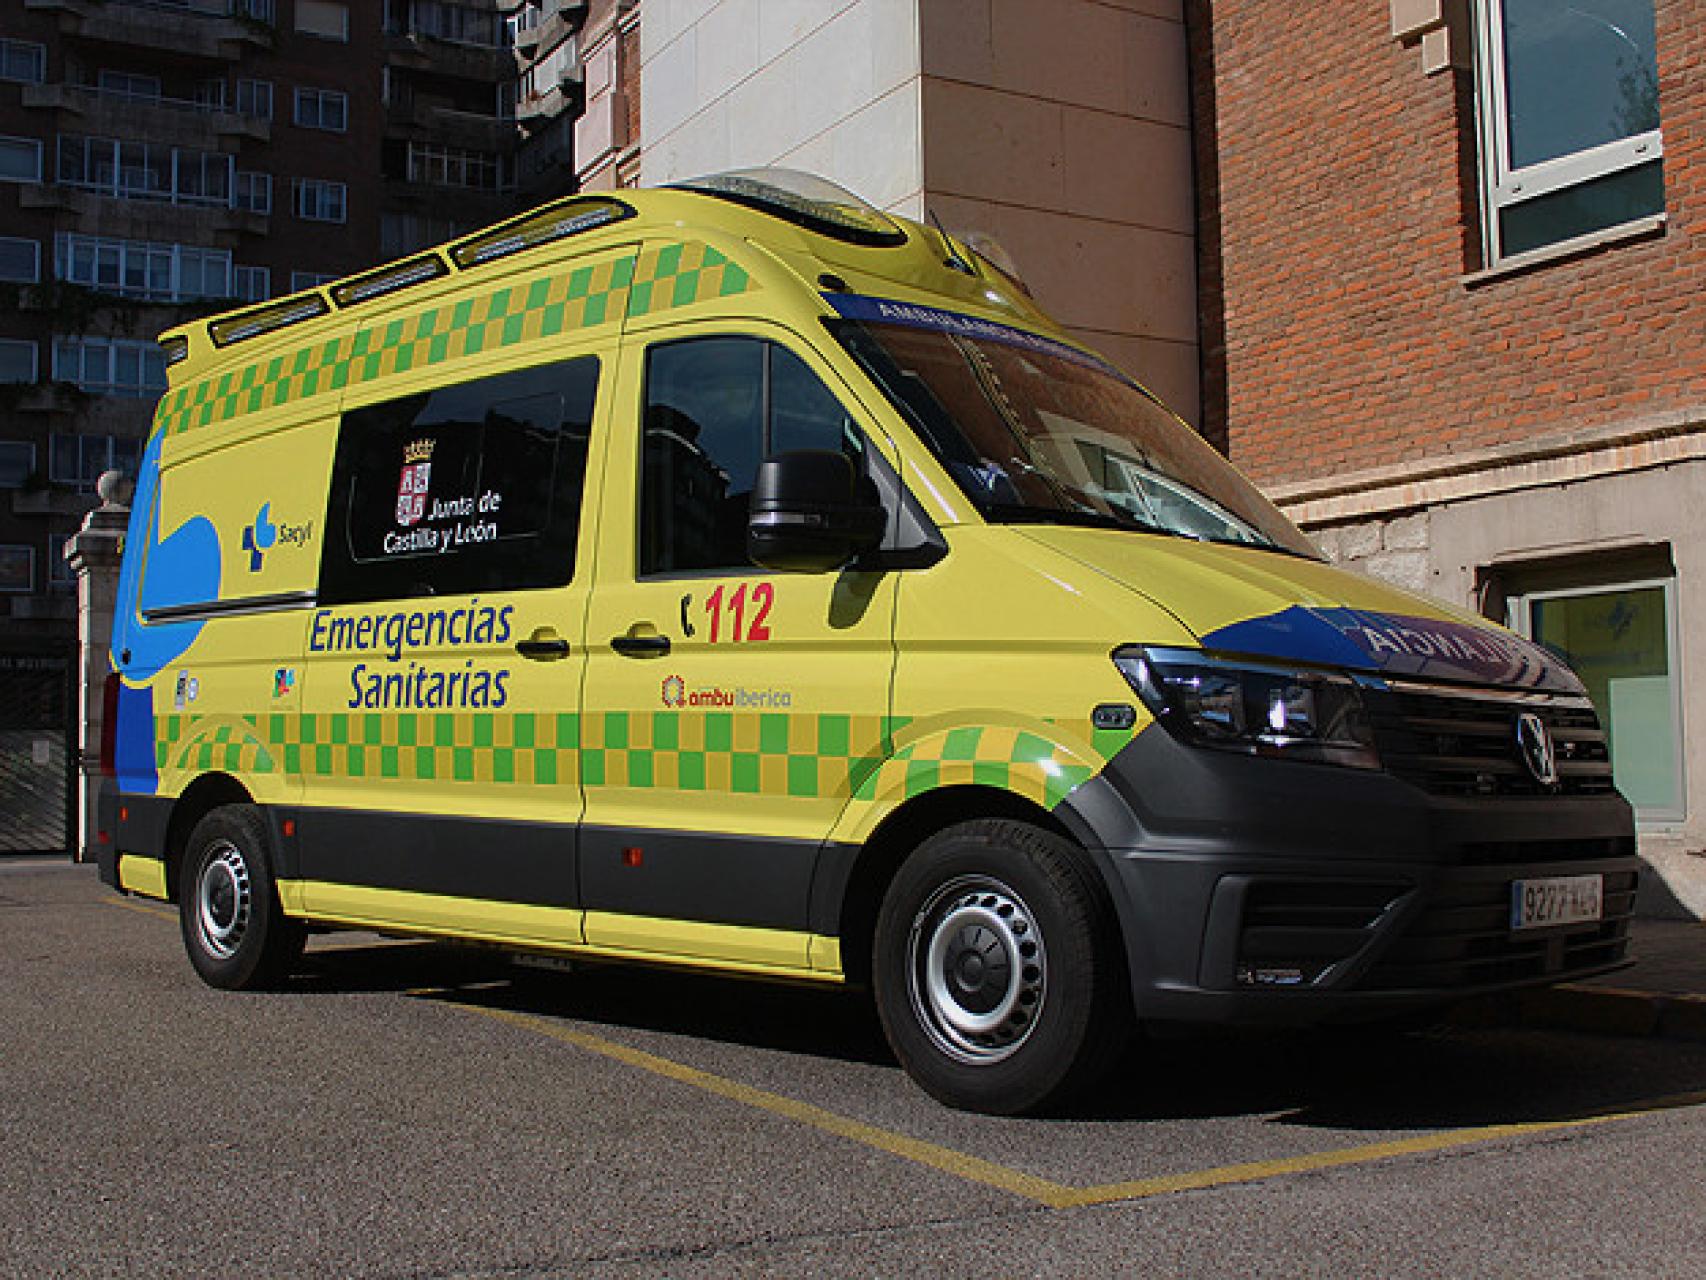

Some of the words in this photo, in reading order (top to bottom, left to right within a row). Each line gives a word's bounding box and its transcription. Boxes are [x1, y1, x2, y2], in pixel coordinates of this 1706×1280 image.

[427, 497, 474, 521] Junta
[478, 490, 502, 513] de
[278, 520, 312, 548] Sacyl
[383, 528, 438, 554] Castilla
[439, 528, 453, 554] y
[455, 520, 497, 545] León
[310, 597, 514, 662] Emergencias
[705, 582, 775, 643] 112
[348, 660, 510, 708] Sanitarias
